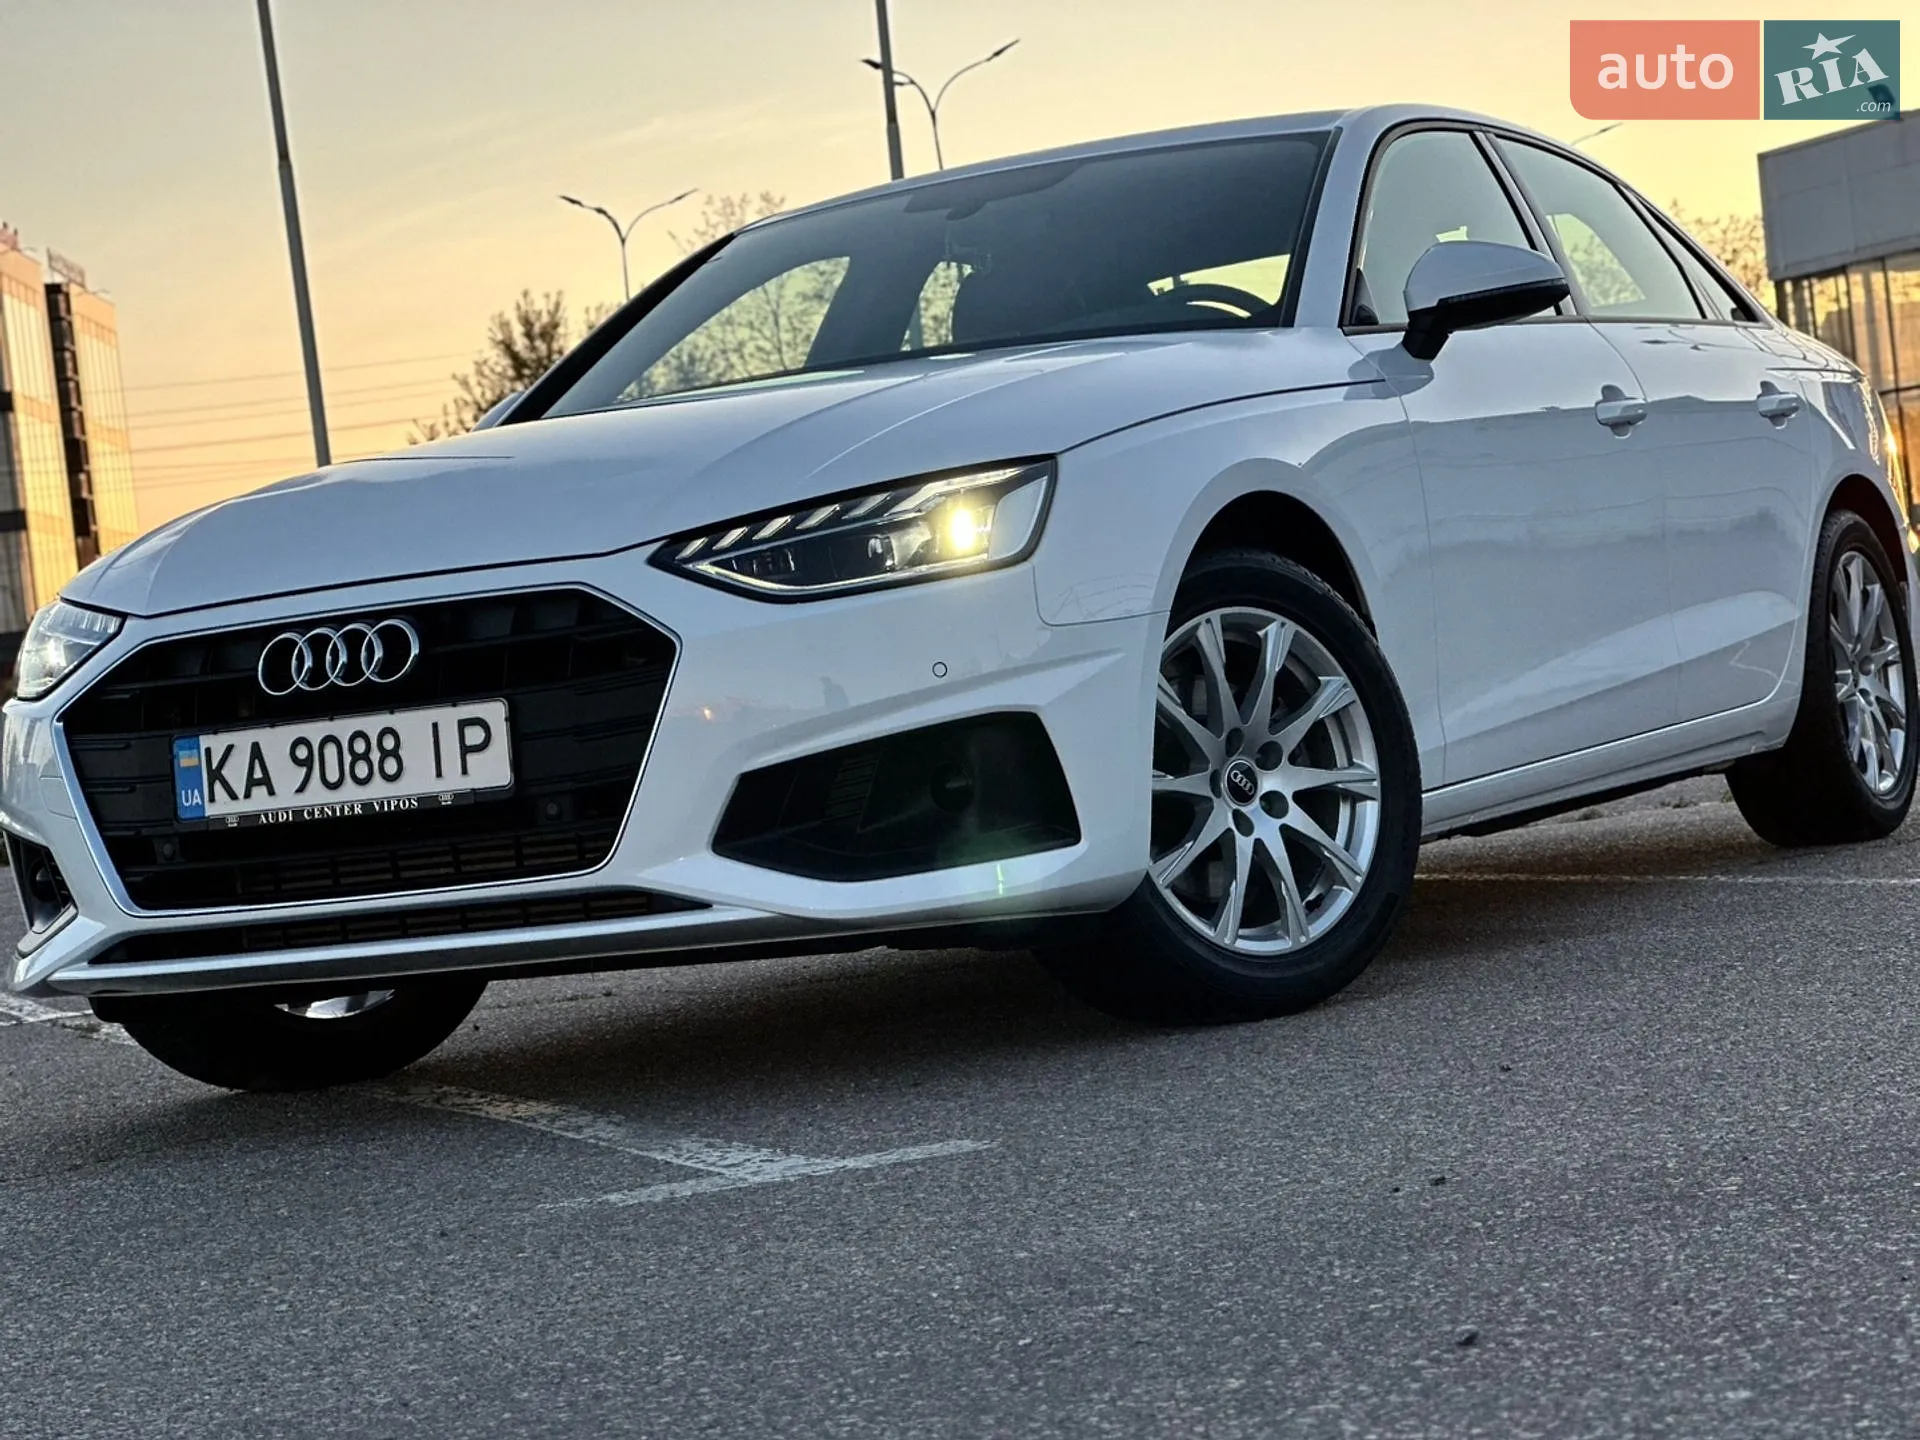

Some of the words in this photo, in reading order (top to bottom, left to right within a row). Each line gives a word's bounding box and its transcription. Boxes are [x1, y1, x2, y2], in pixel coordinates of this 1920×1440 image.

[204, 741, 276, 803] KA
[289, 726, 404, 794] 9088
[431, 716, 493, 778] IP
[182, 789, 201, 807] UA
[258, 810, 294, 825] AUDI
[303, 804, 363, 820] CENTER
[372, 797, 419, 812] VIPOS
